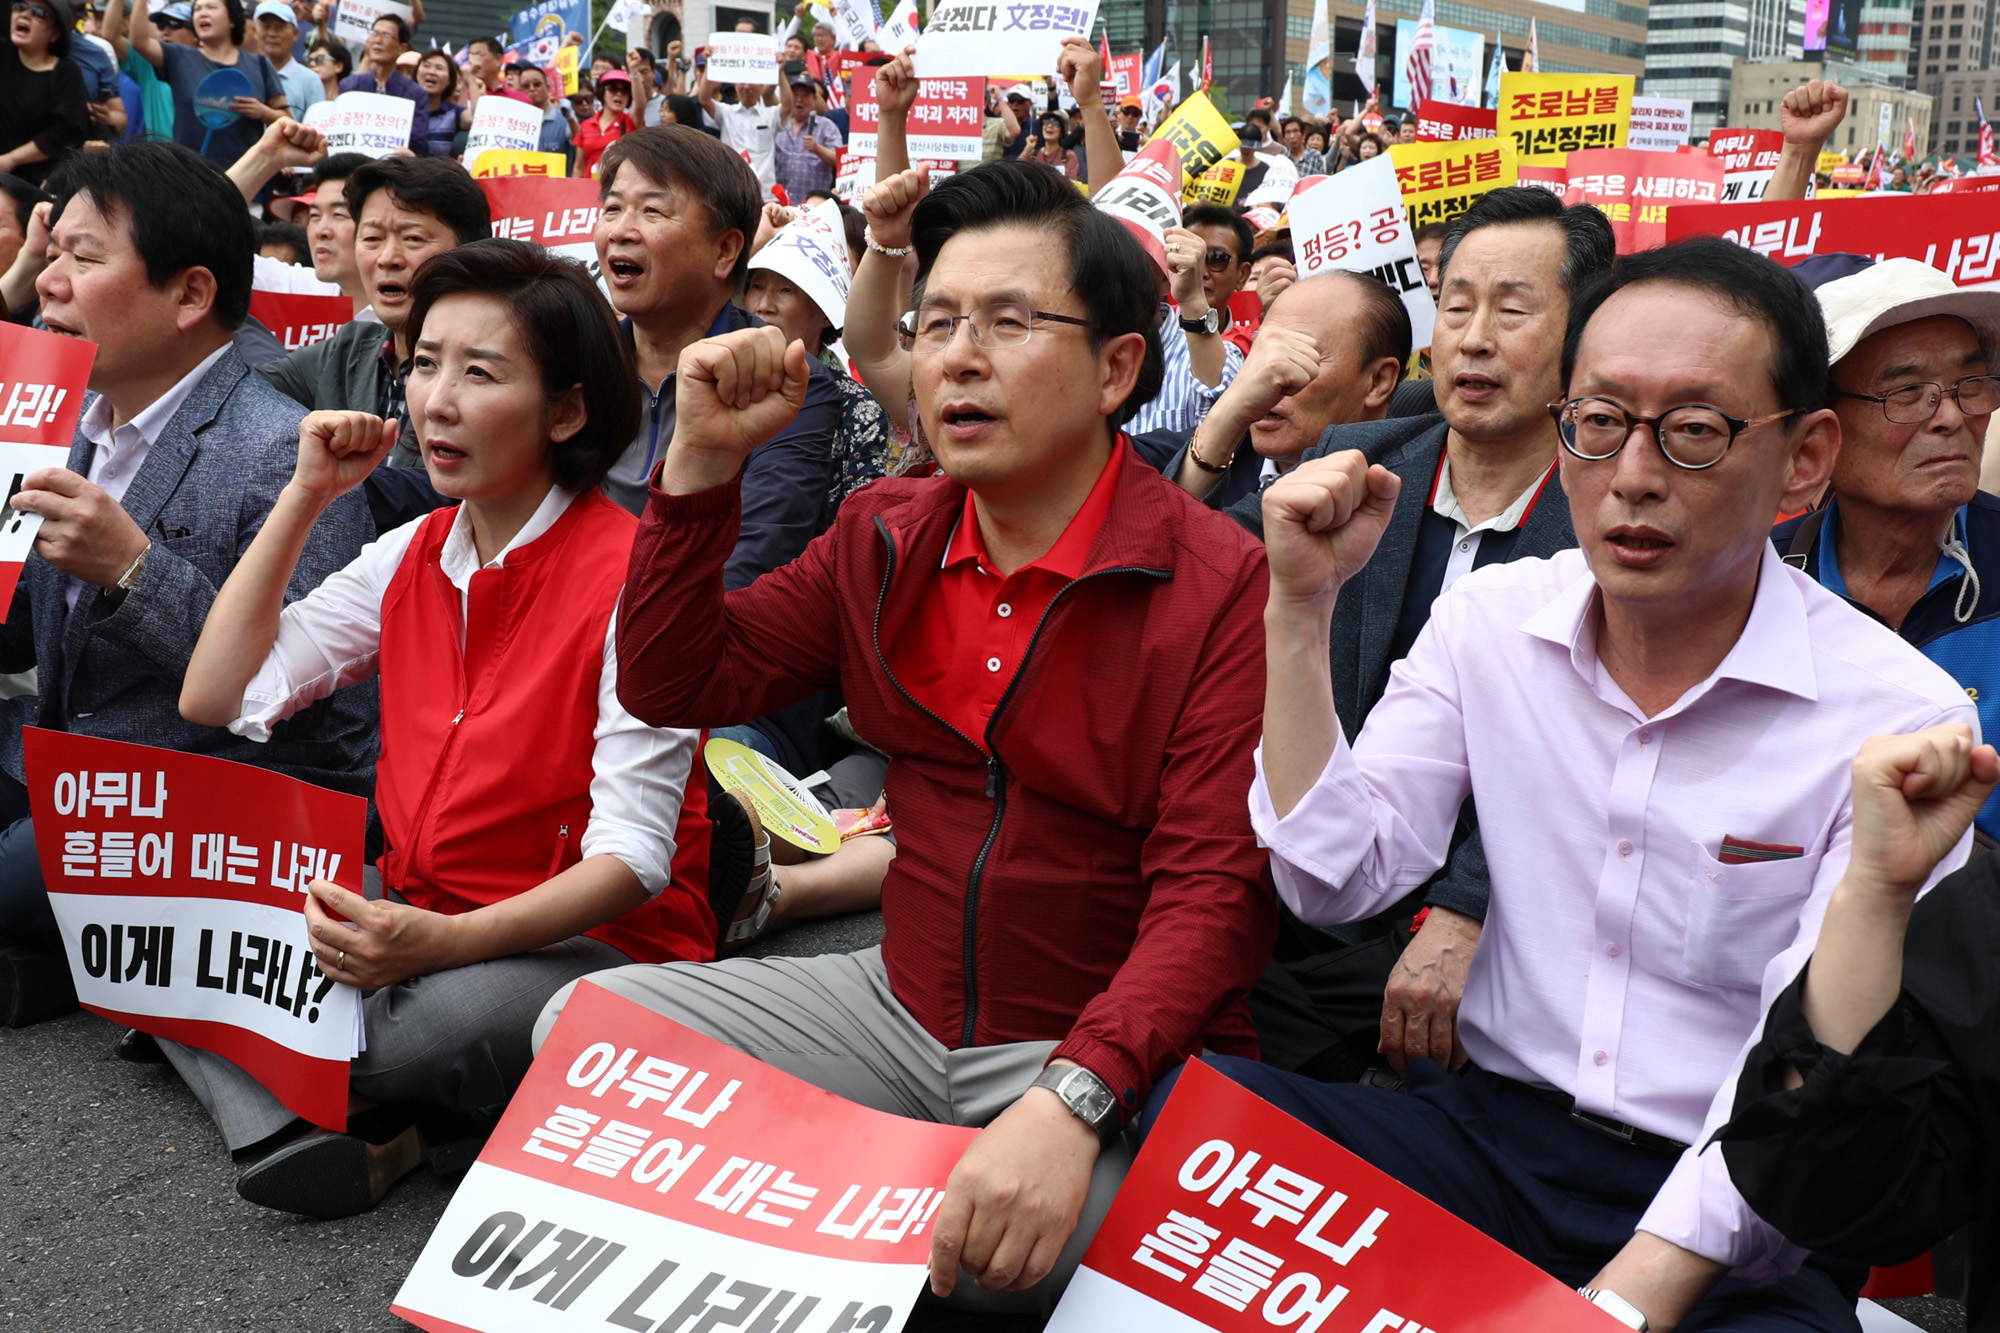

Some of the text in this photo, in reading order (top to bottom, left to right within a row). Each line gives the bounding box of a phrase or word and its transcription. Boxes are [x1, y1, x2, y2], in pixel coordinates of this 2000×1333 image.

[1003, 3, 1089, 35] 文정권!
[914, 104, 942, 124] 파괴
[946, 105, 978, 125] 저지!
[1510, 86, 1619, 120] 조로남불
[375, 113, 408, 130] 정의?
[507, 117, 537, 136] 정의?
[1417, 118, 1454, 140] 조국은
[327, 132, 356, 148] 찾겠다
[910, 141, 975, 153] 경산시당원협의회
[1163, 117, 1223, 180] 정권!
[1510, 123, 1617, 156] 위선정권!
[1713, 134, 1755, 154] 아무나
[1198, 166, 1236, 184] 남불
[1395, 149, 1502, 196] 조로남불
[1718, 151, 1781, 170] 들어 대는
[1183, 182, 1230, 205] 선정권!
[1632, 176, 1717, 202] 사퇴하고
[1721, 181, 1743, 201] 게
[1409, 192, 1485, 231] 선정
[1303, 219, 1362, 271] 평등?
[1718, 211, 1823, 258] 아무나
[54, 771, 168, 819] 아무나
[62, 830, 342, 894] 흔들어 대는 나라!
[81, 922, 337, 1024] 이게 나라냐?
[565, 1041, 743, 1130] 아무나
[521, 1104, 947, 1244] 흔들어 대는 나라!
[1177, 1138, 1390, 1267] 아무나
[451, 1210, 628, 1312] 이게
[1131, 1209, 1350, 1333] 흔들어
